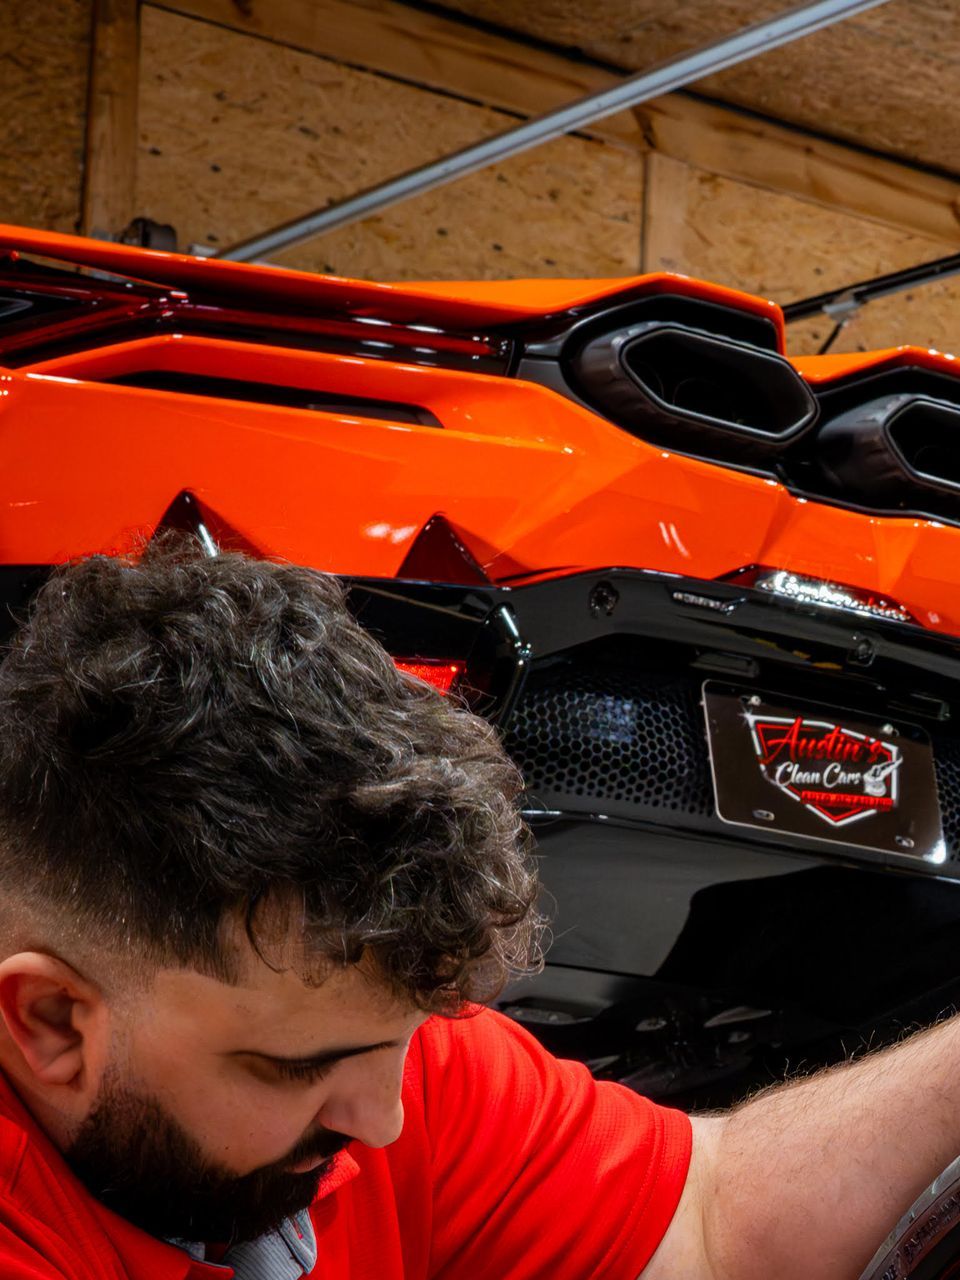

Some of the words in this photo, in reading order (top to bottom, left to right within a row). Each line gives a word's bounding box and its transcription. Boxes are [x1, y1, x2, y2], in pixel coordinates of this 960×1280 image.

[763, 715, 882, 764] Austin's
[775, 761, 821, 789] Clean
[822, 762, 861, 788] Cars
